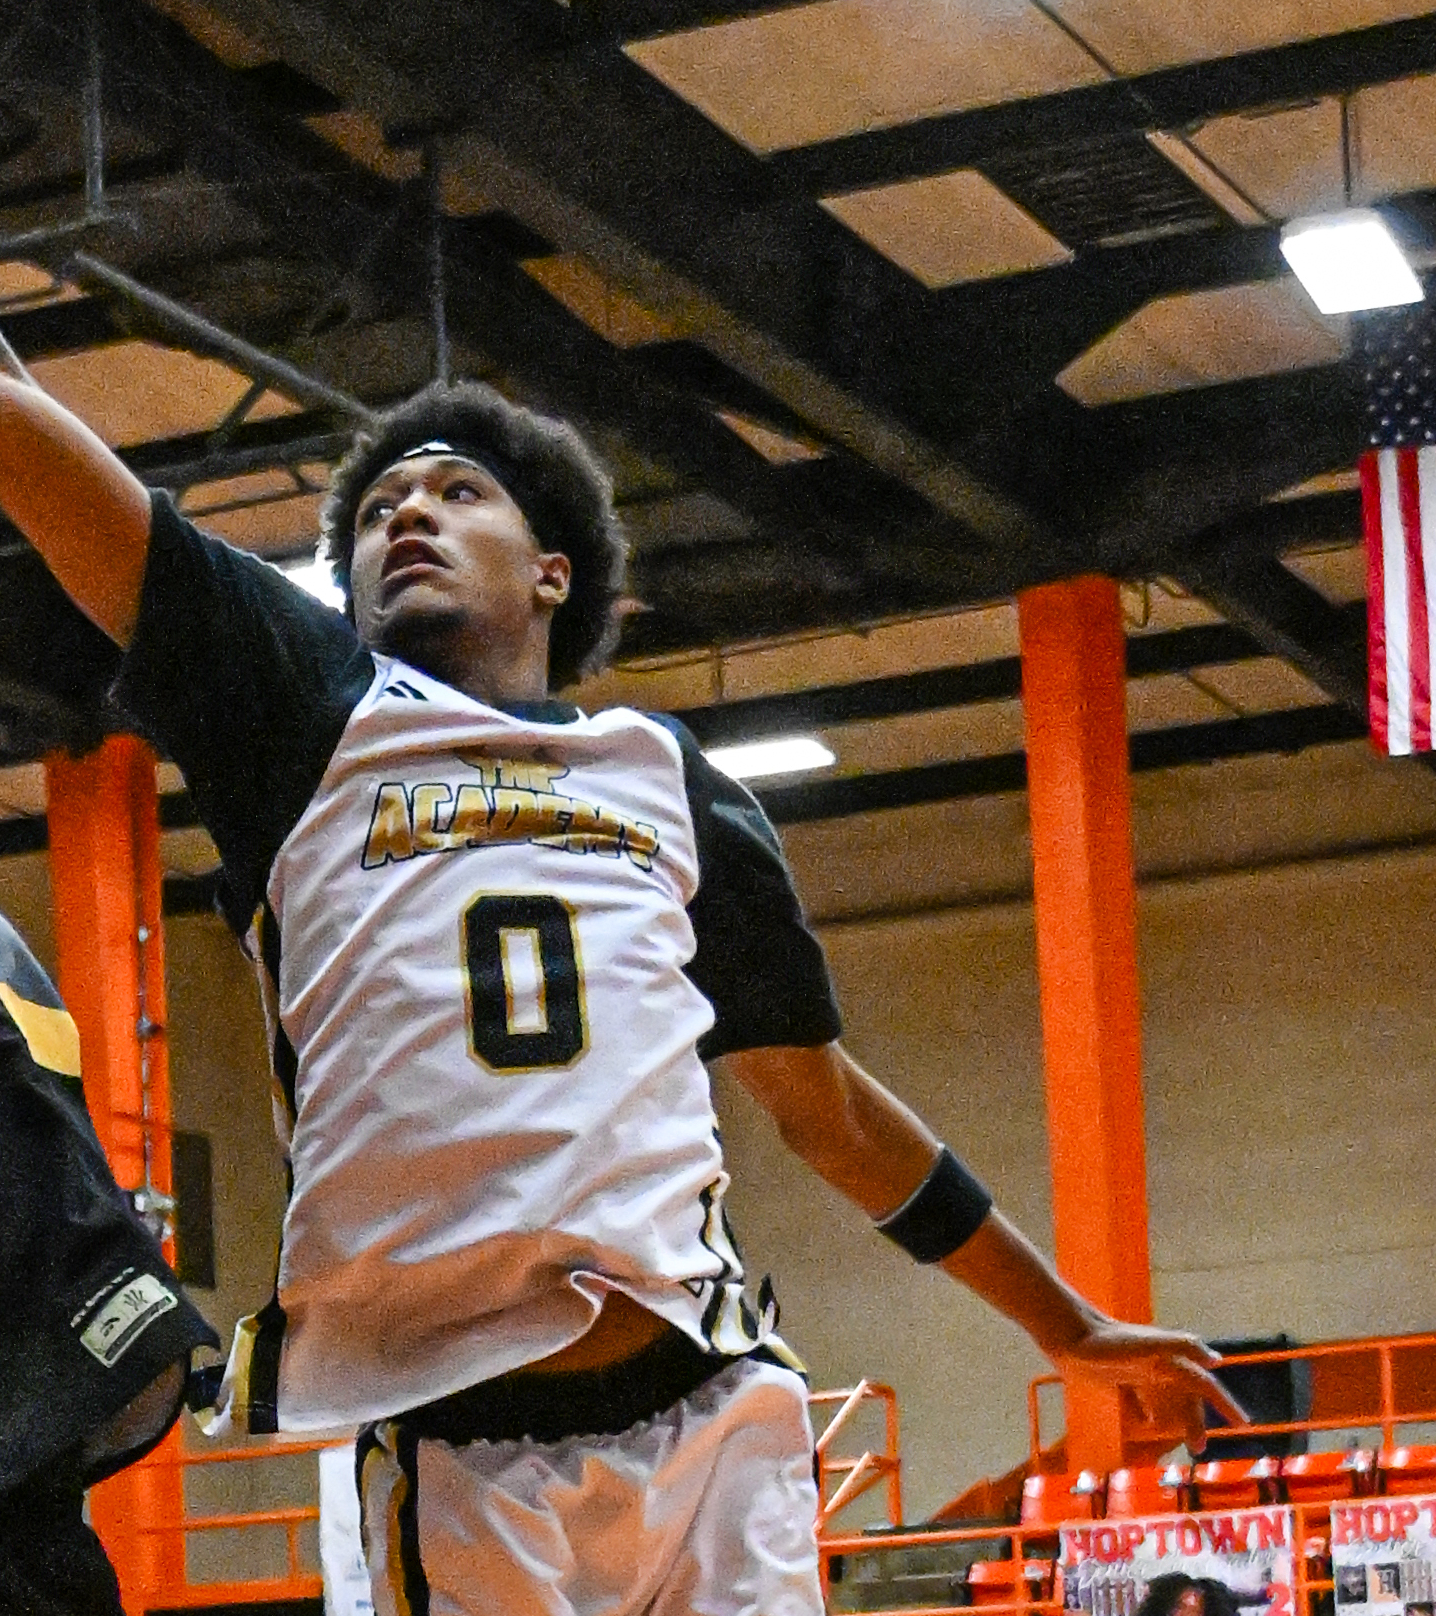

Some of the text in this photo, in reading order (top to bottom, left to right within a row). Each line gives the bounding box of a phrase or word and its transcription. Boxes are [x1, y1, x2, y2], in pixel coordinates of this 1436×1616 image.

[361, 782, 660, 872] ACADEMY
[459, 889, 591, 1076] 0
[1065, 1511, 1287, 1567] HOPTOWN
